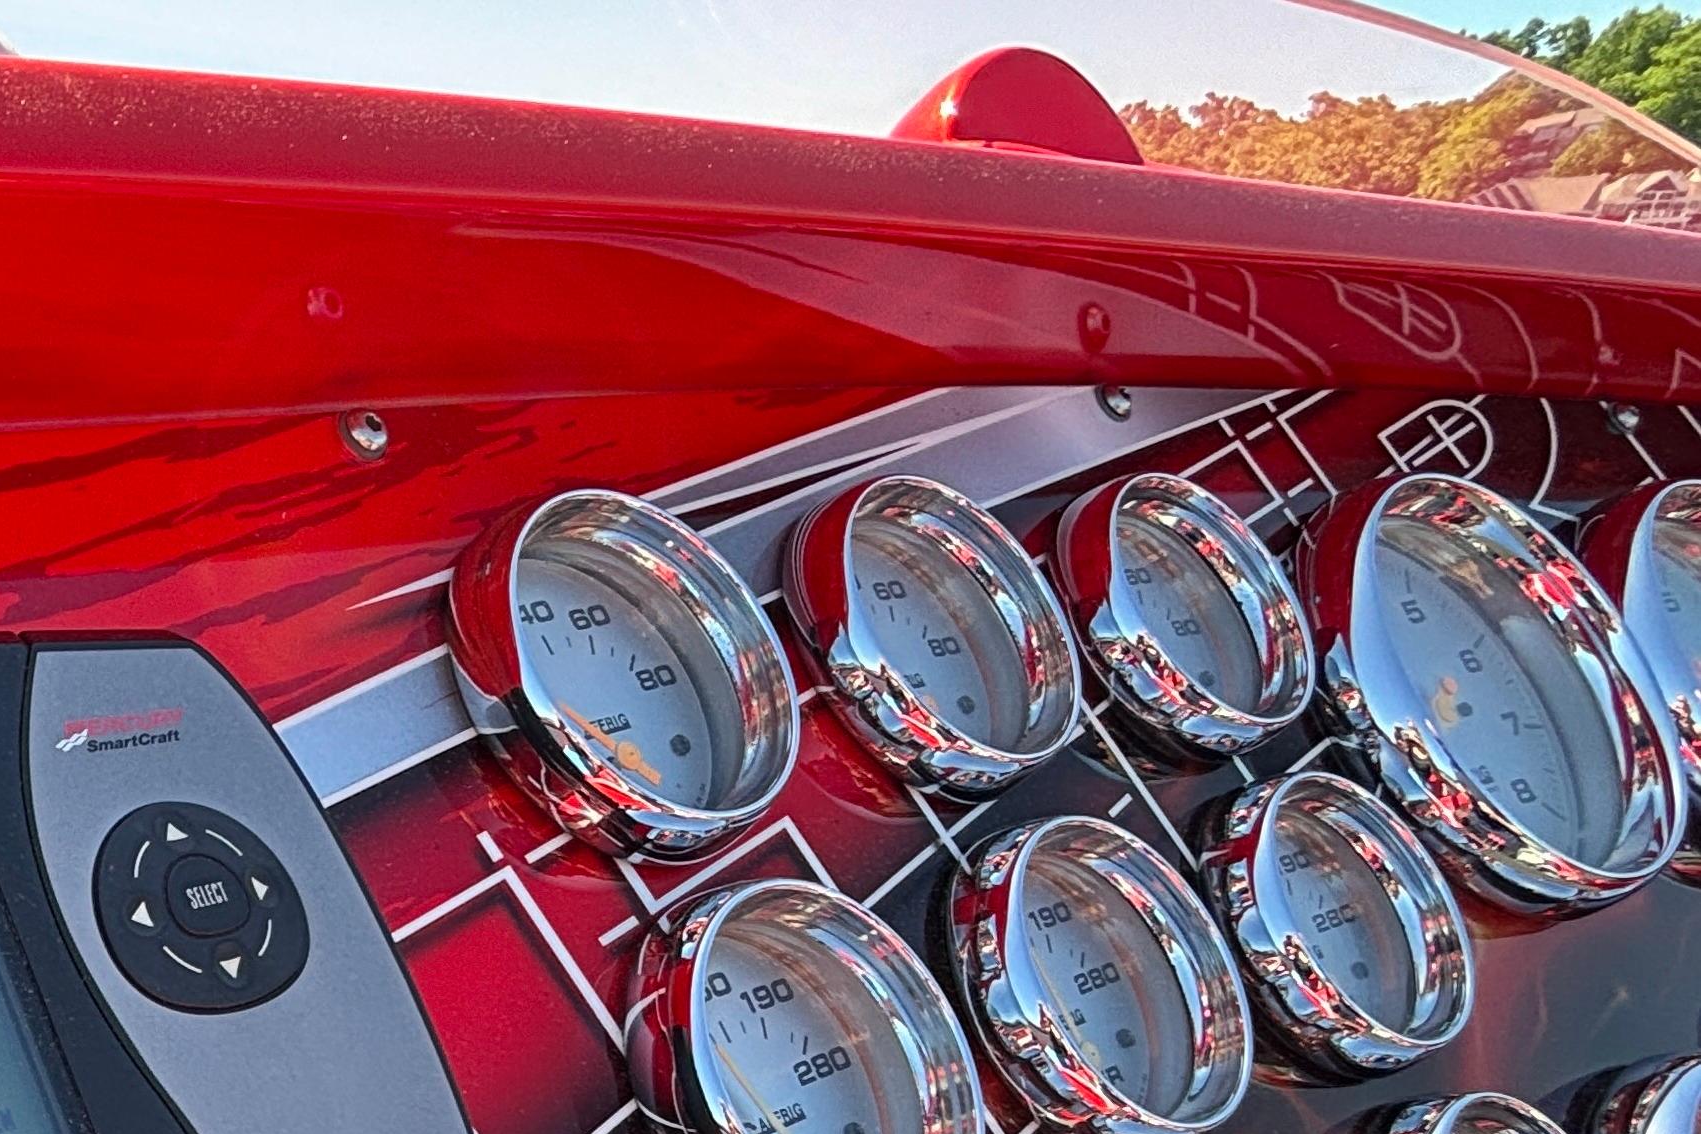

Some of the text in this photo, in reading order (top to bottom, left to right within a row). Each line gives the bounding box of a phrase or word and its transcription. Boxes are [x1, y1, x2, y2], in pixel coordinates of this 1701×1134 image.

[873, 580, 908, 600] 60
[519, 600, 554, 624] 40
[568, 604, 611, 630] 60
[1401, 599, 1426, 624] 5
[1171, 619, 1201, 636] 80
[928, 637, 961, 657] 80
[1458, 649, 1483, 673] 6
[634, 664, 677, 691] 80
[1500, 711, 1520, 736] 7
[86, 729, 181, 753] SmartCraft
[1510, 778, 1537, 804] 8
[1277, 850, 1310, 875] 90
[185, 881, 229, 909] SELECT
[1028, 901, 1072, 931] 190
[1311, 904, 1357, 933] 280
[1074, 962, 1120, 995] 280
[740, 978, 794, 1014] 190
[793, 1045, 852, 1087] 280
